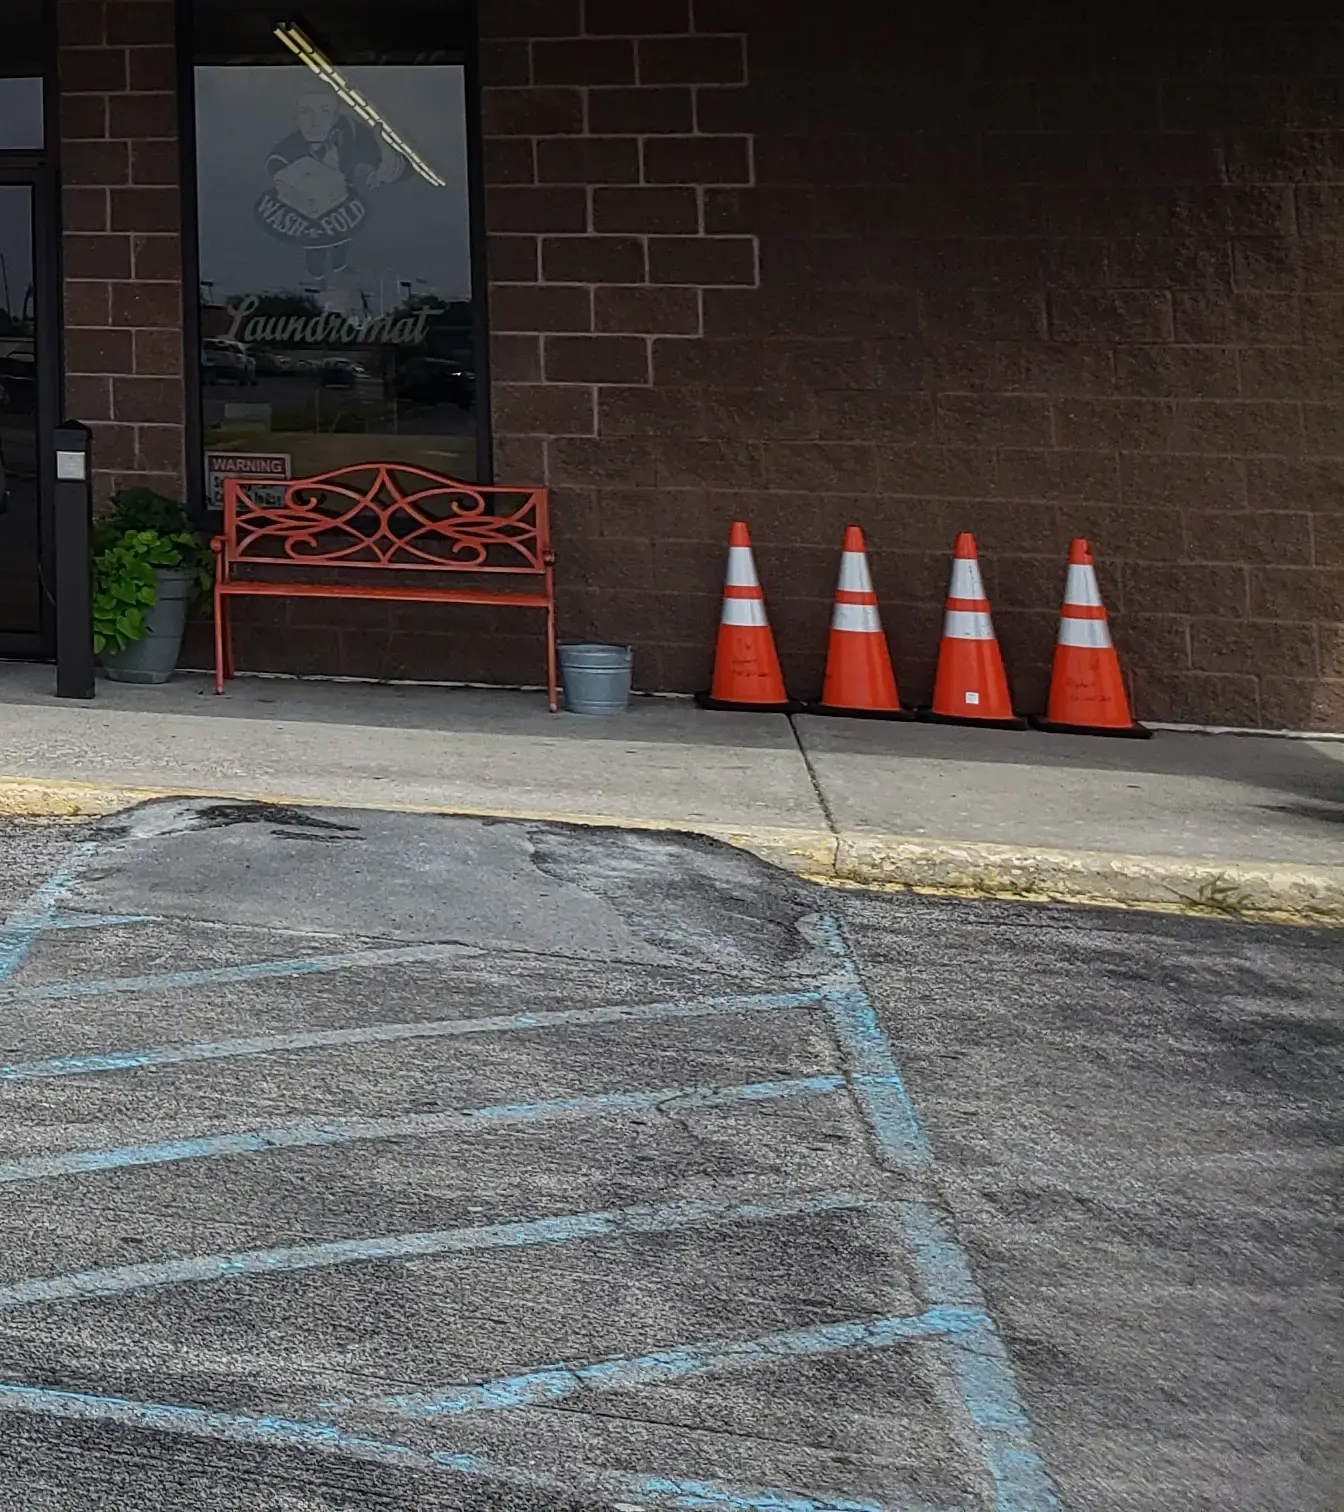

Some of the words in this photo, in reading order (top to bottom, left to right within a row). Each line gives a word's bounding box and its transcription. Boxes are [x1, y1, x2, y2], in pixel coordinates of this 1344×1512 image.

[258, 195, 308, 237] WASH
[320, 199, 366, 237] FOLD
[219, 295, 445, 345] Laundromat
[212, 458, 283, 472] WARNING
